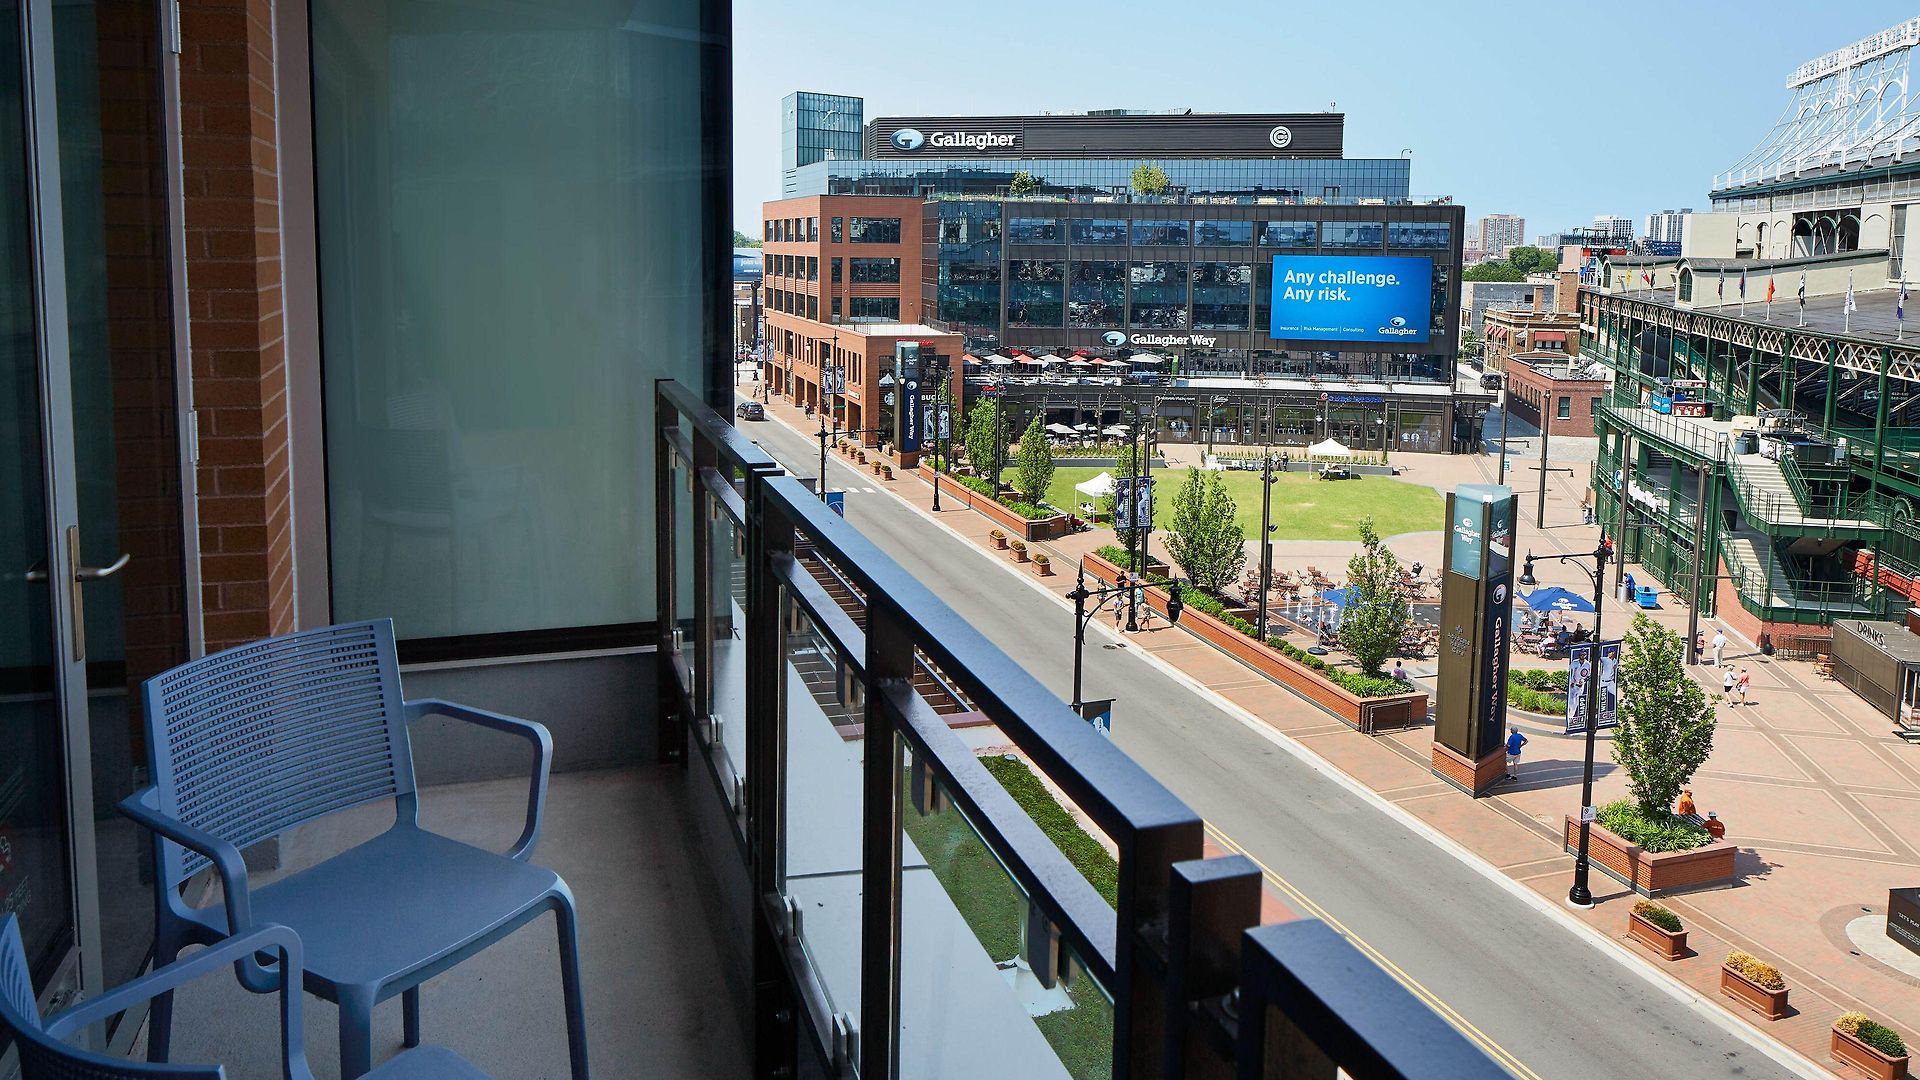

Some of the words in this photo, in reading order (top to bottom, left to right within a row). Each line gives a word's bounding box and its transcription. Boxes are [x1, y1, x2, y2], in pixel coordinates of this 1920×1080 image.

[930, 131, 1016, 150] Gallagher
[1283, 269, 1314, 286] Any
[1318, 270, 1400, 287] challenge.
[1283, 286, 1314, 303] Any
[1318, 287, 1351, 301] risk.
[1378, 326, 1417, 336] Gallagher
[1130, 333, 1189, 347] Gallagher
[1190, 334, 1217, 348] Way
[1454, 525, 1480, 539] Gallagher
[1461, 533, 1473, 545] Way
[1857, 620, 1884, 646] DRINKS
[1492, 616, 1502, 690] Gallagher
[1489, 690, 1498, 722] Way
[1600, 686, 1608, 712] WILSON
